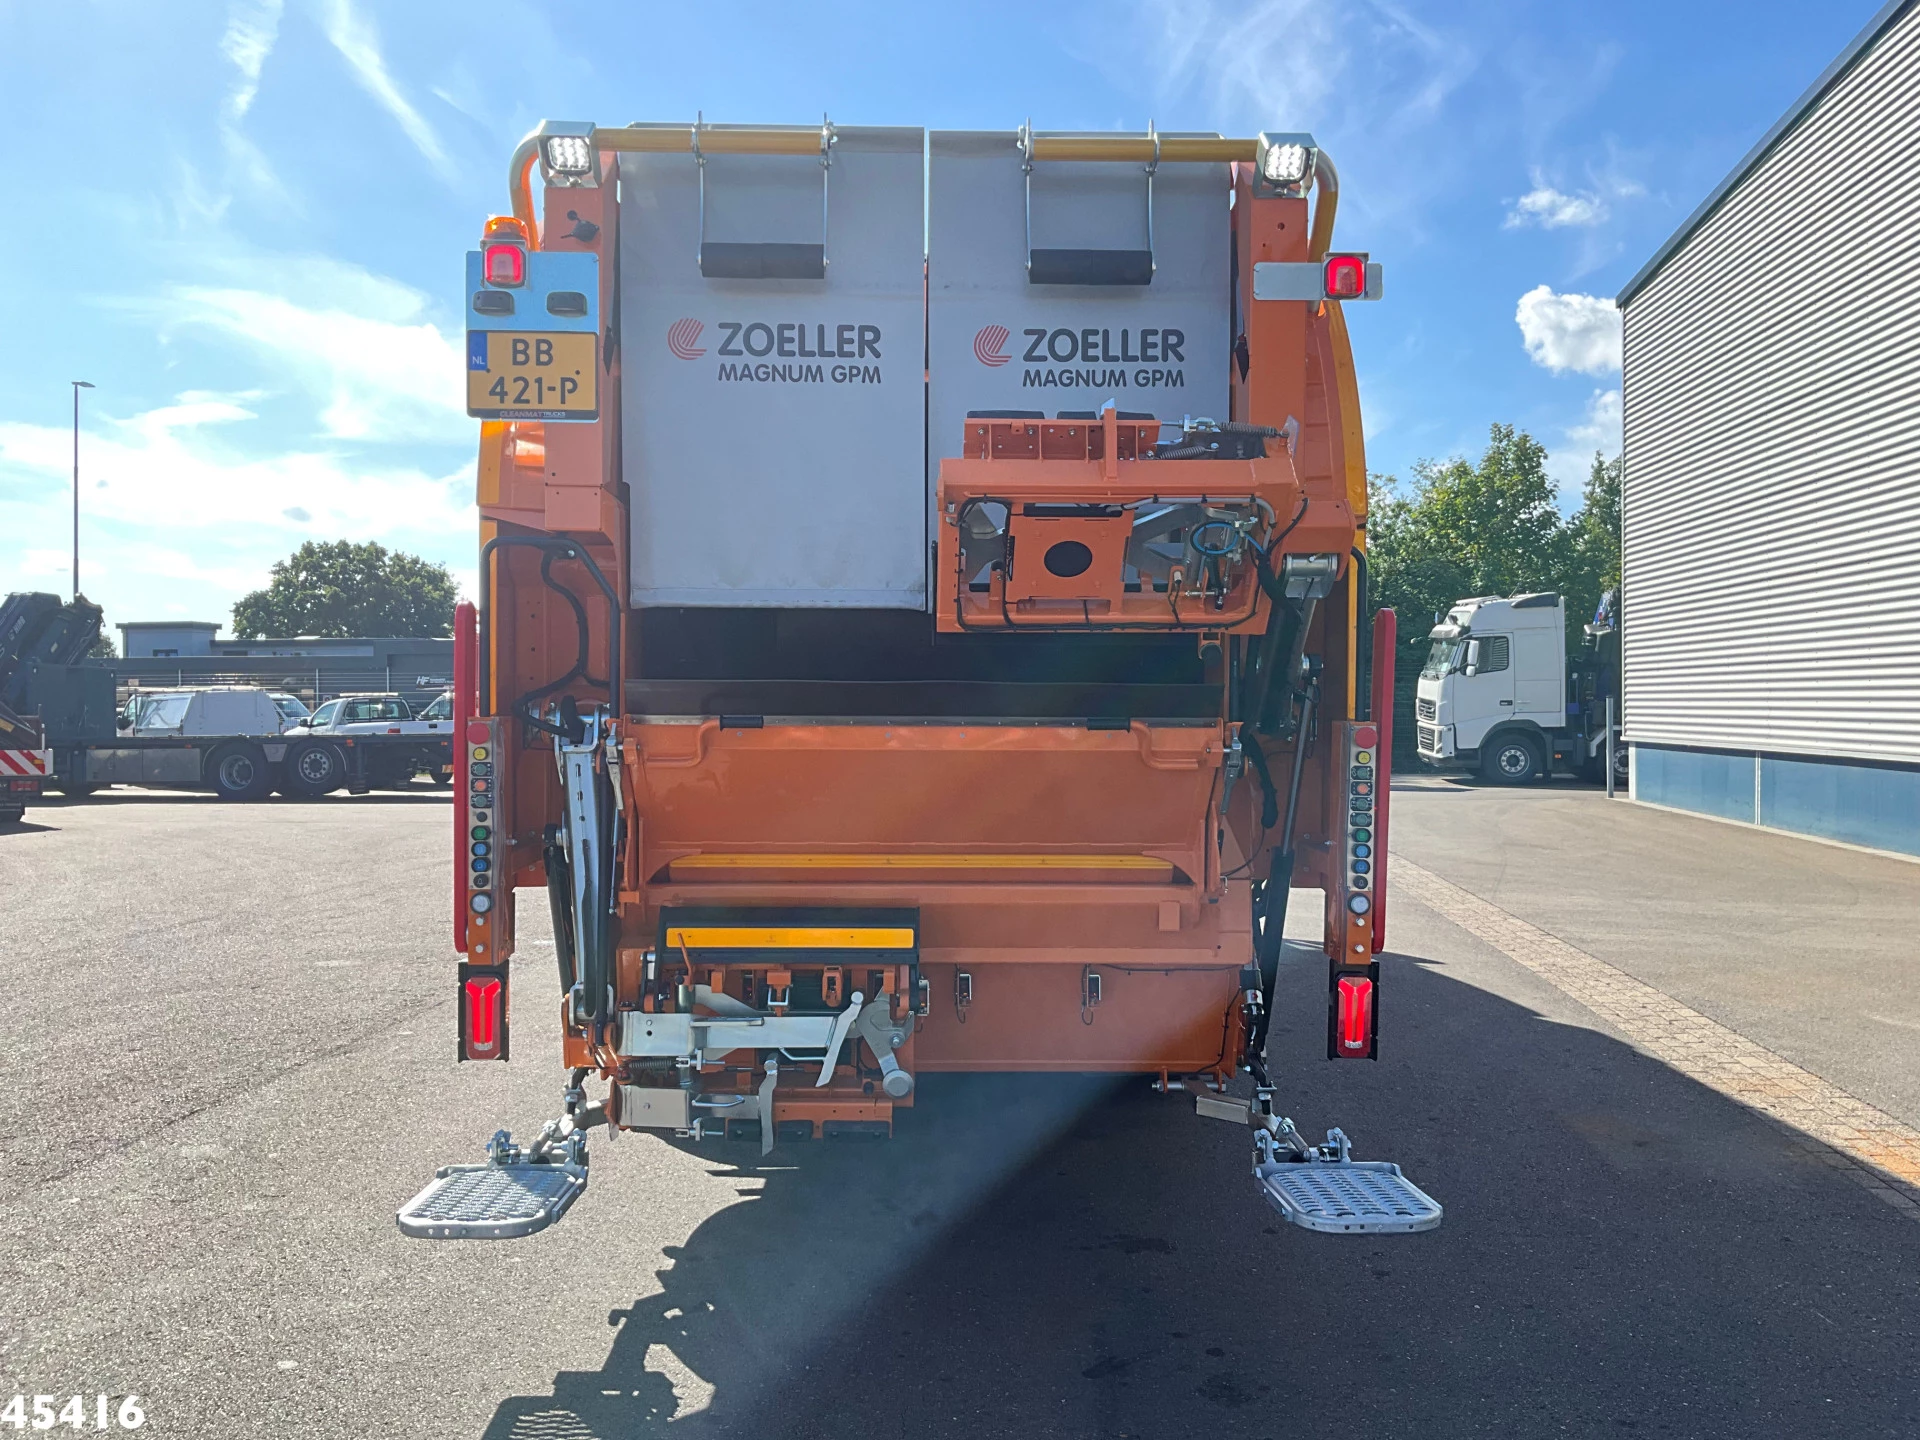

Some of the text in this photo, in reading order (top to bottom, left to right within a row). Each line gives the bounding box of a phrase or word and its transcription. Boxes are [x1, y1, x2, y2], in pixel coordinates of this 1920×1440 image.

[512, 338, 553, 366] BB
[718, 322, 881, 359] ZOELLER
[1022, 328, 1185, 363] ZOELLER
[472, 356, 485, 365] NL
[718, 363, 881, 384] MAGNUM GPM
[488, 376, 578, 404] 421-P
[1022, 369, 1185, 388] MAGNUM GPM
